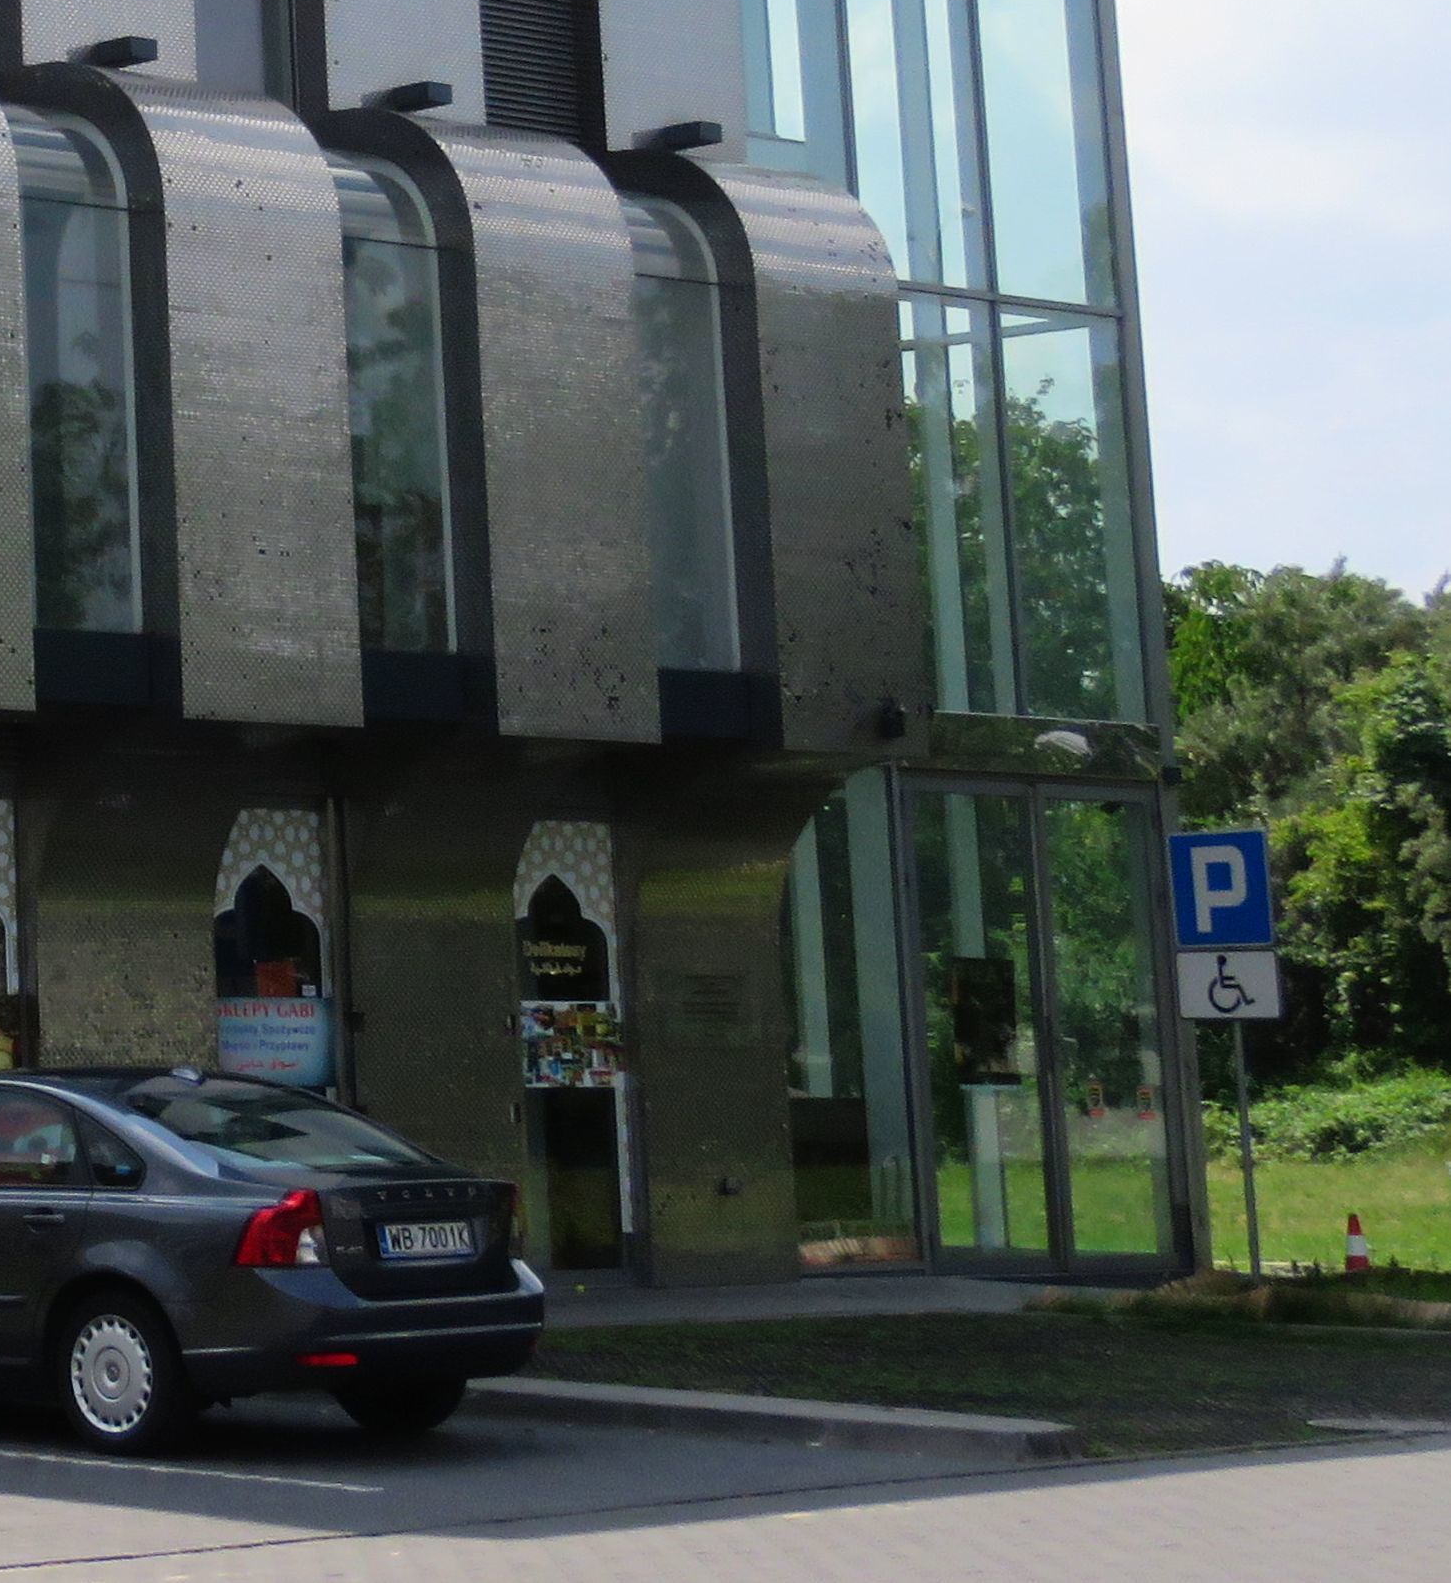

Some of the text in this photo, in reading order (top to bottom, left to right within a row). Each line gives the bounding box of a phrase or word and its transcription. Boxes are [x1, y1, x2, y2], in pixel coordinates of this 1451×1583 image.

[1190, 845, 1247, 933] P
[276, 1002, 315, 1017] GABI
[377, 1185, 476, 1200] VOLVO
[389, 1227, 414, 1250] WB
